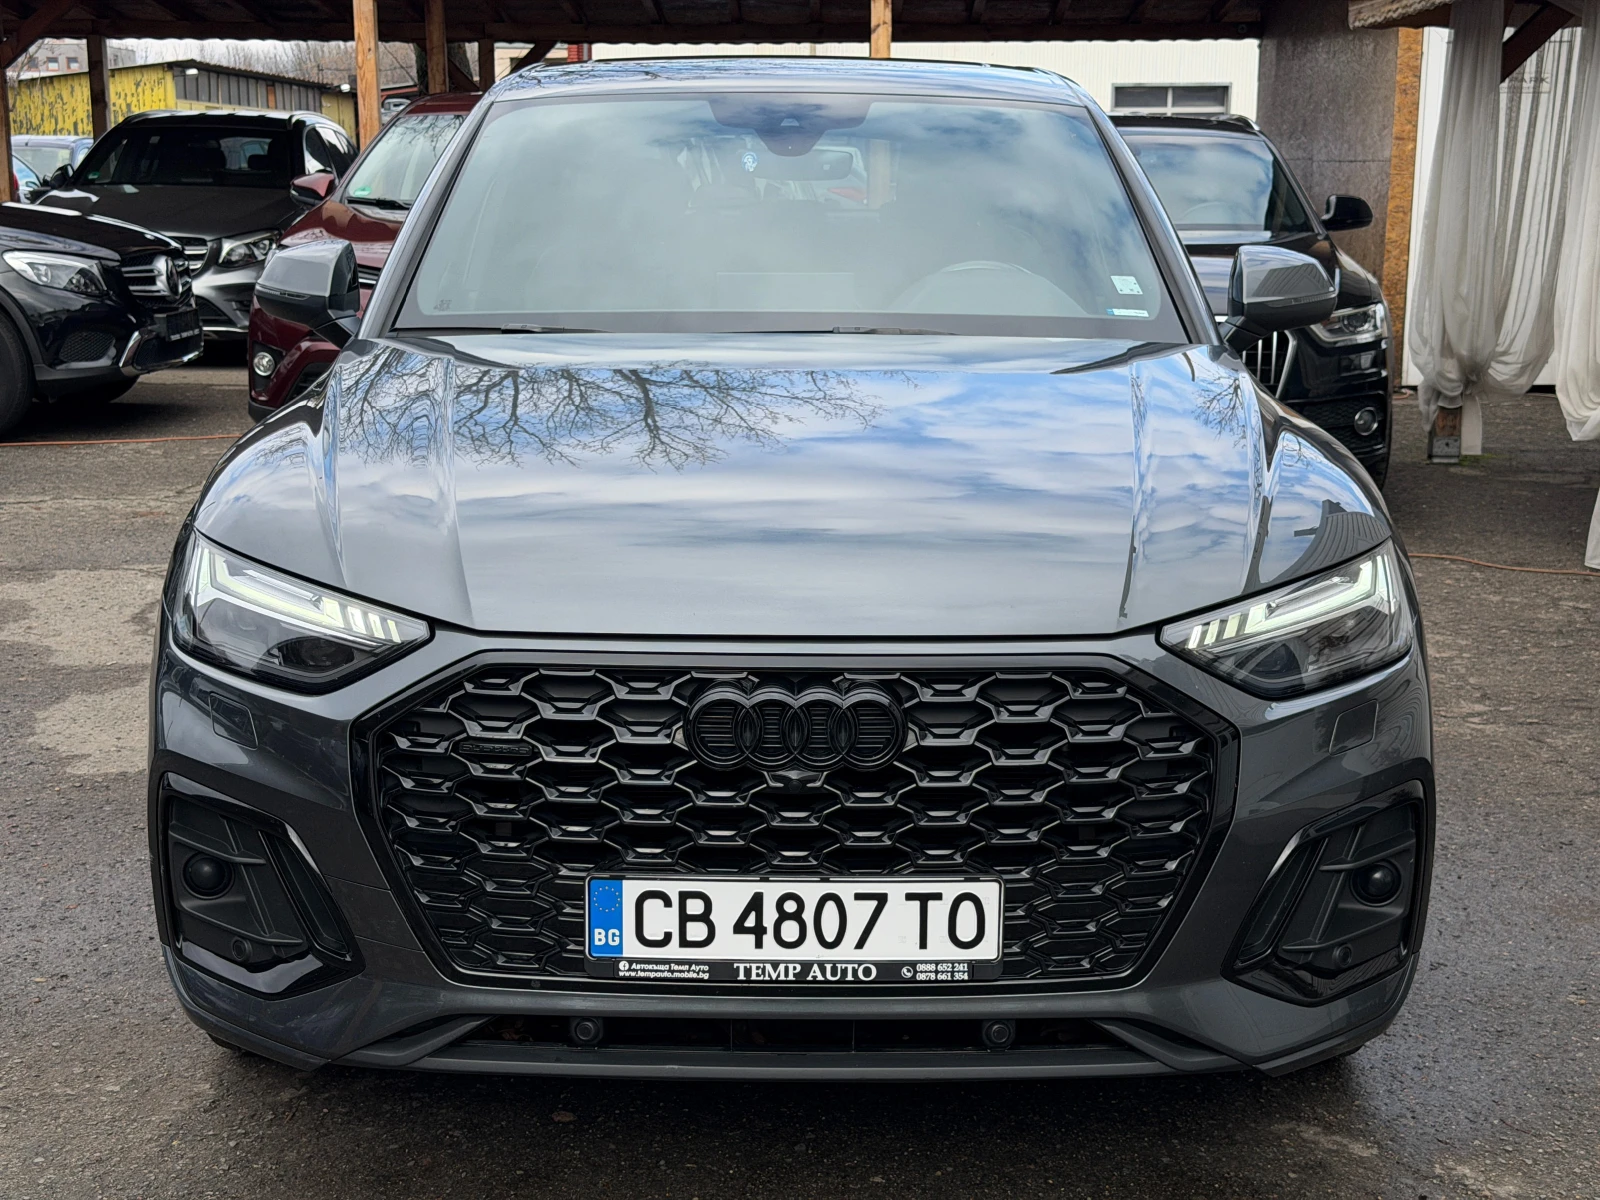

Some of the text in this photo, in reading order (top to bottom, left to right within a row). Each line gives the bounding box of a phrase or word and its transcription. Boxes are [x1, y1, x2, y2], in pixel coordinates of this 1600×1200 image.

[635, 889, 986, 950] CB 4807 TO
[594, 928, 620, 946] BG
[690, 963, 709, 972] Ауто
[733, 963, 878, 981] TEMP AUTO
[915, 962, 969, 972] 0888 652 241
[618, 970, 710, 980] www.tempauto.mobile.bg
[915, 972, 969, 981] 0878 661 354
